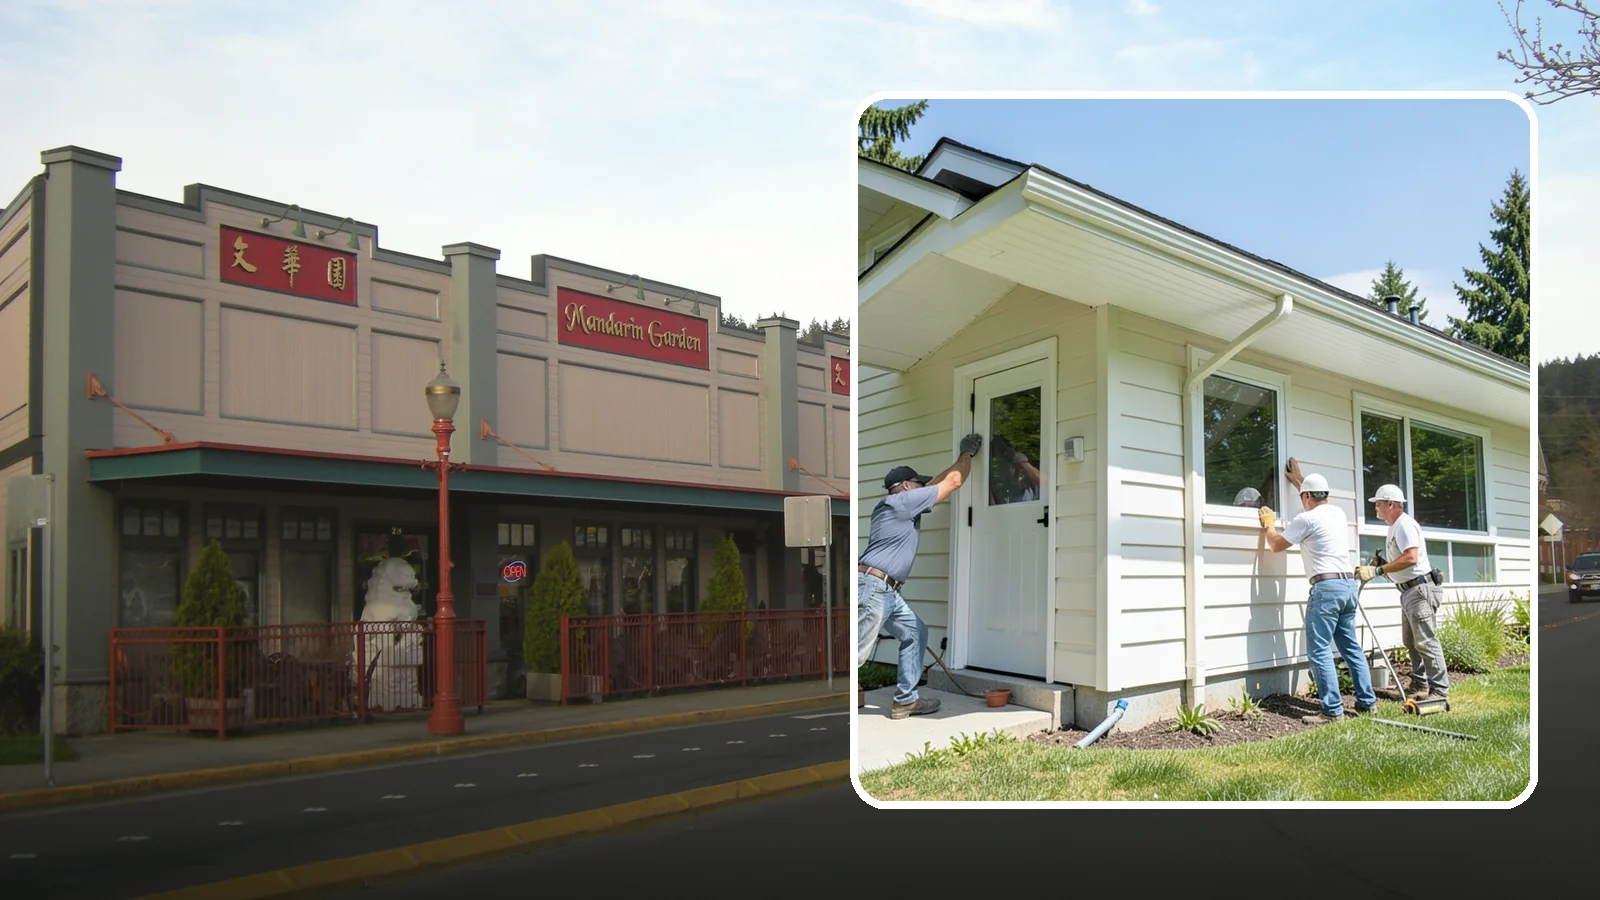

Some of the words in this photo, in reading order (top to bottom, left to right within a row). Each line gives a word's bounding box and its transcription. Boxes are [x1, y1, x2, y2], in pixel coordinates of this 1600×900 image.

[231, 235, 346, 291] 文華園
[564, 302, 644, 341] Mandarin
[648, 320, 702, 352] Garden
[503, 565, 527, 578] OPEN
